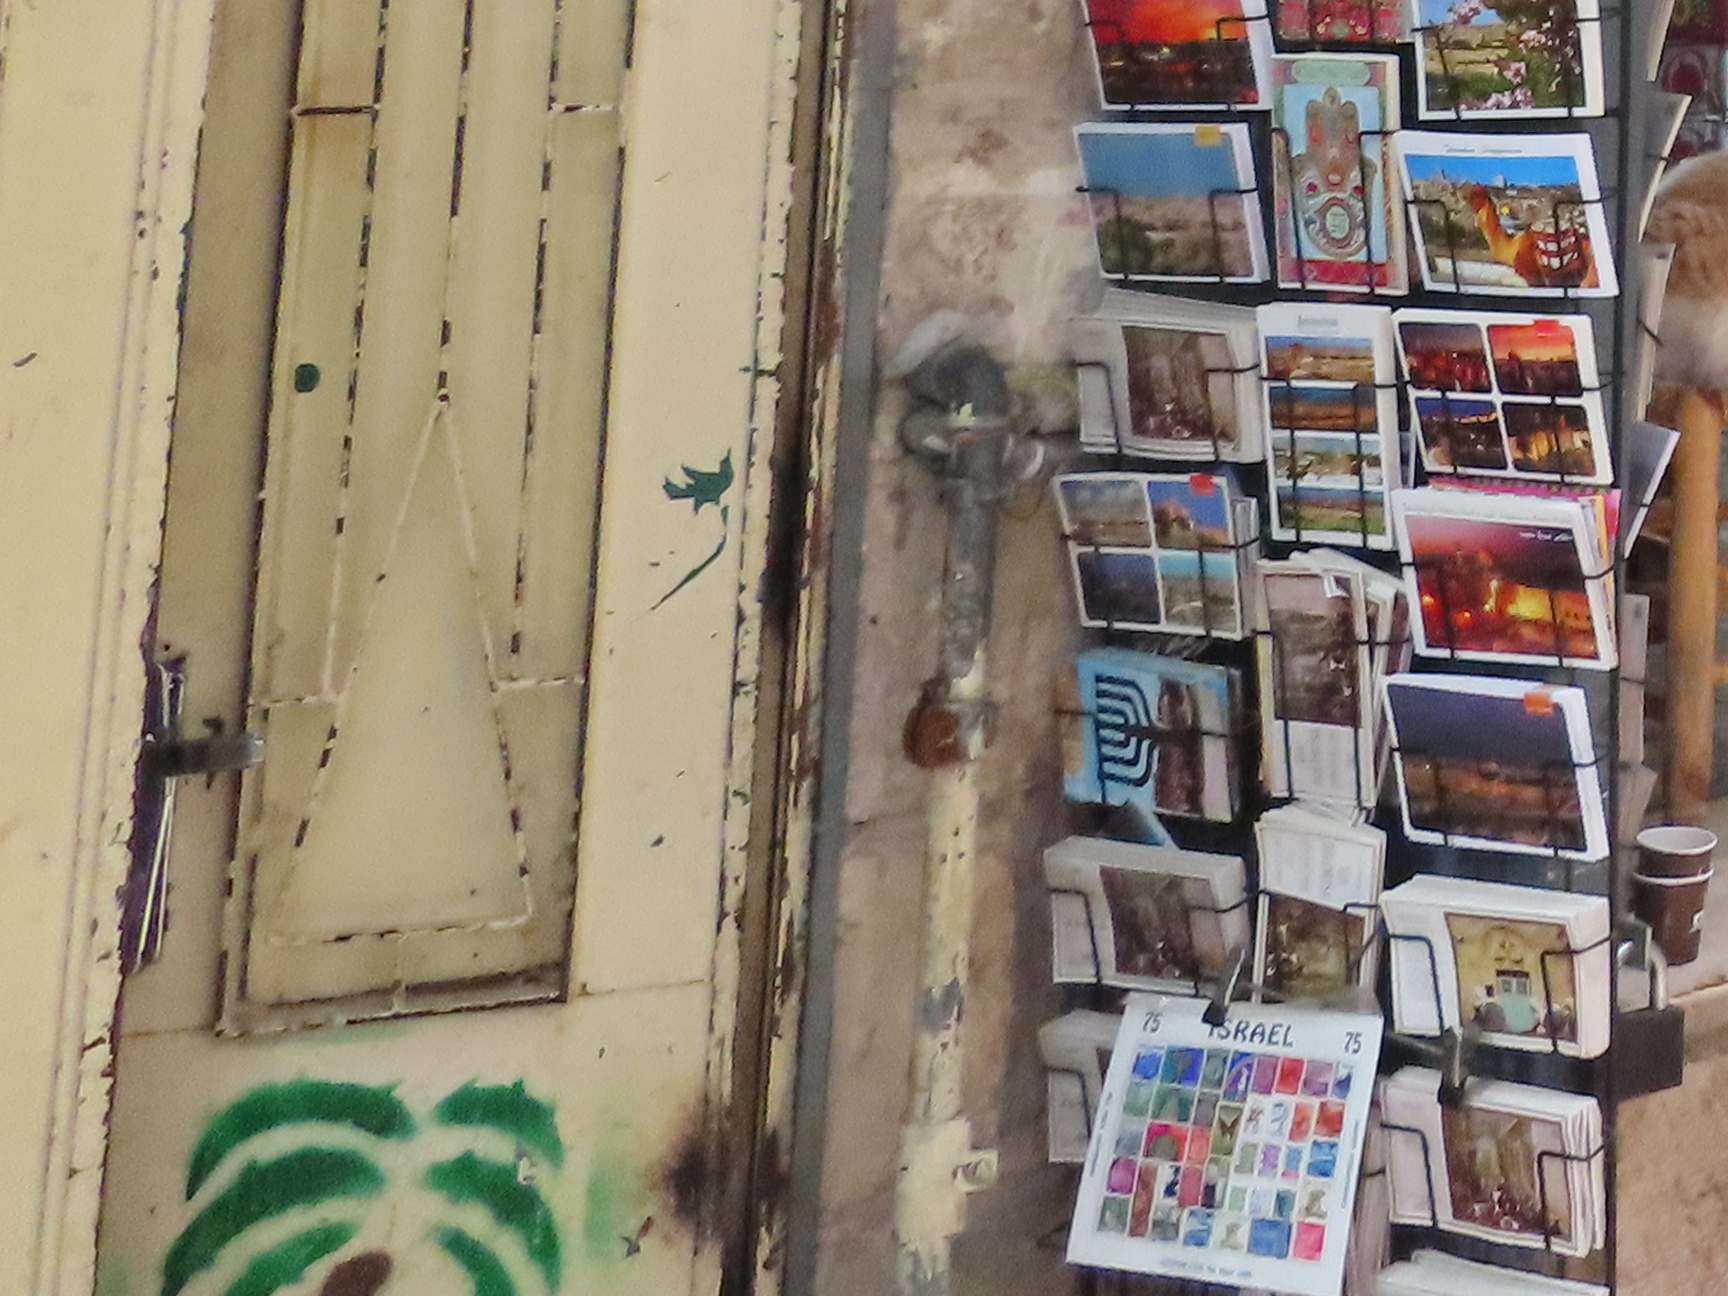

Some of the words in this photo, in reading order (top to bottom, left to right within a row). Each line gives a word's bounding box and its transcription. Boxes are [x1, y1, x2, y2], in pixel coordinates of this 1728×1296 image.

[1141, 1011, 1163, 1034] 75
[1208, 1019, 1294, 1048] ISRAEL
[1343, 1031, 1362, 1055] 75
